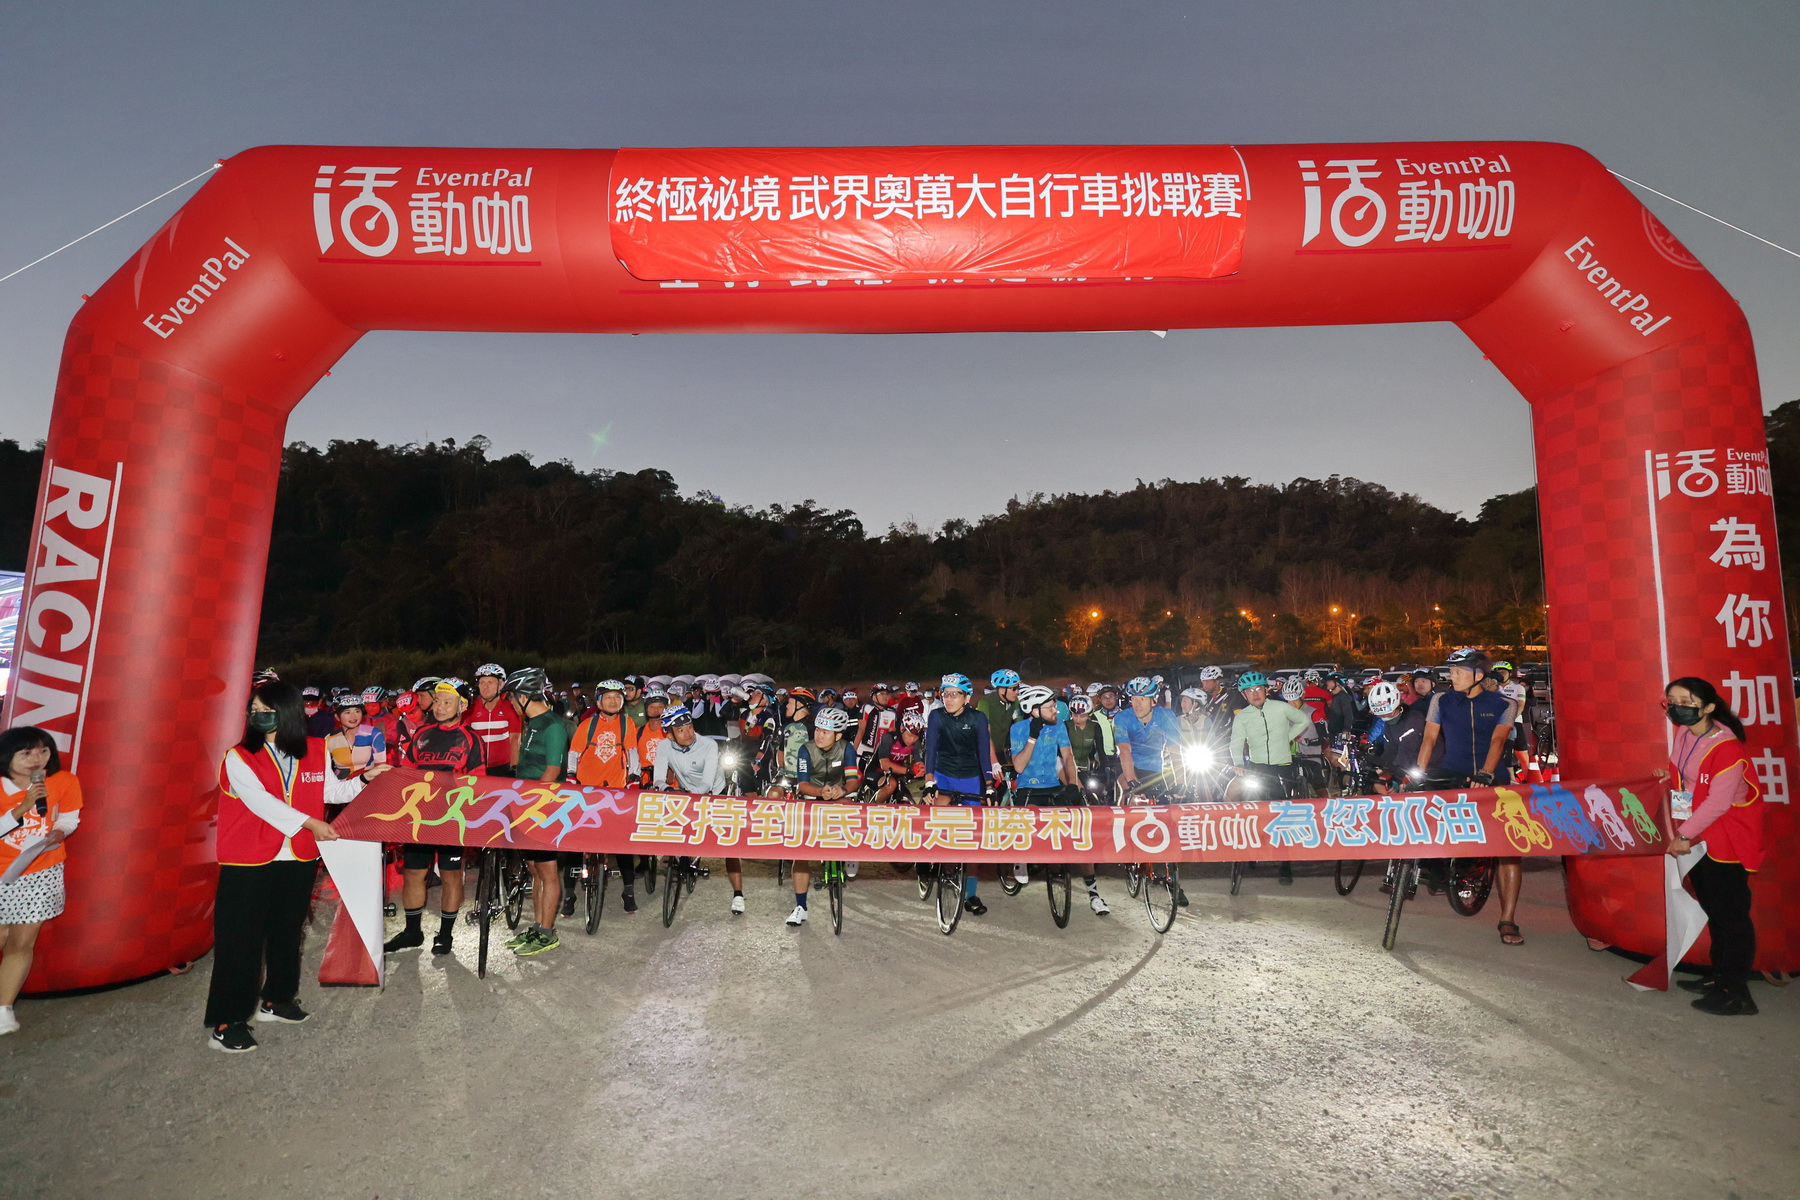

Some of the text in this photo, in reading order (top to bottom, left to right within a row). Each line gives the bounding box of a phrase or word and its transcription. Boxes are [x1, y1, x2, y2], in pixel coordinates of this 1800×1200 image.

[416, 167, 533, 188] EventPal
[1396, 154, 1511, 176] EventPal
[615, 172, 1243, 223] 終極祕境 武界奧萬大自行車挑戰賽
[142, 236, 251, 340] EventPal
[1563, 235, 1672, 337] EventPal
[630, 791, 1094, 852] 堅持到底就是勝利
[1262, 793, 1487, 849] 為您加油
